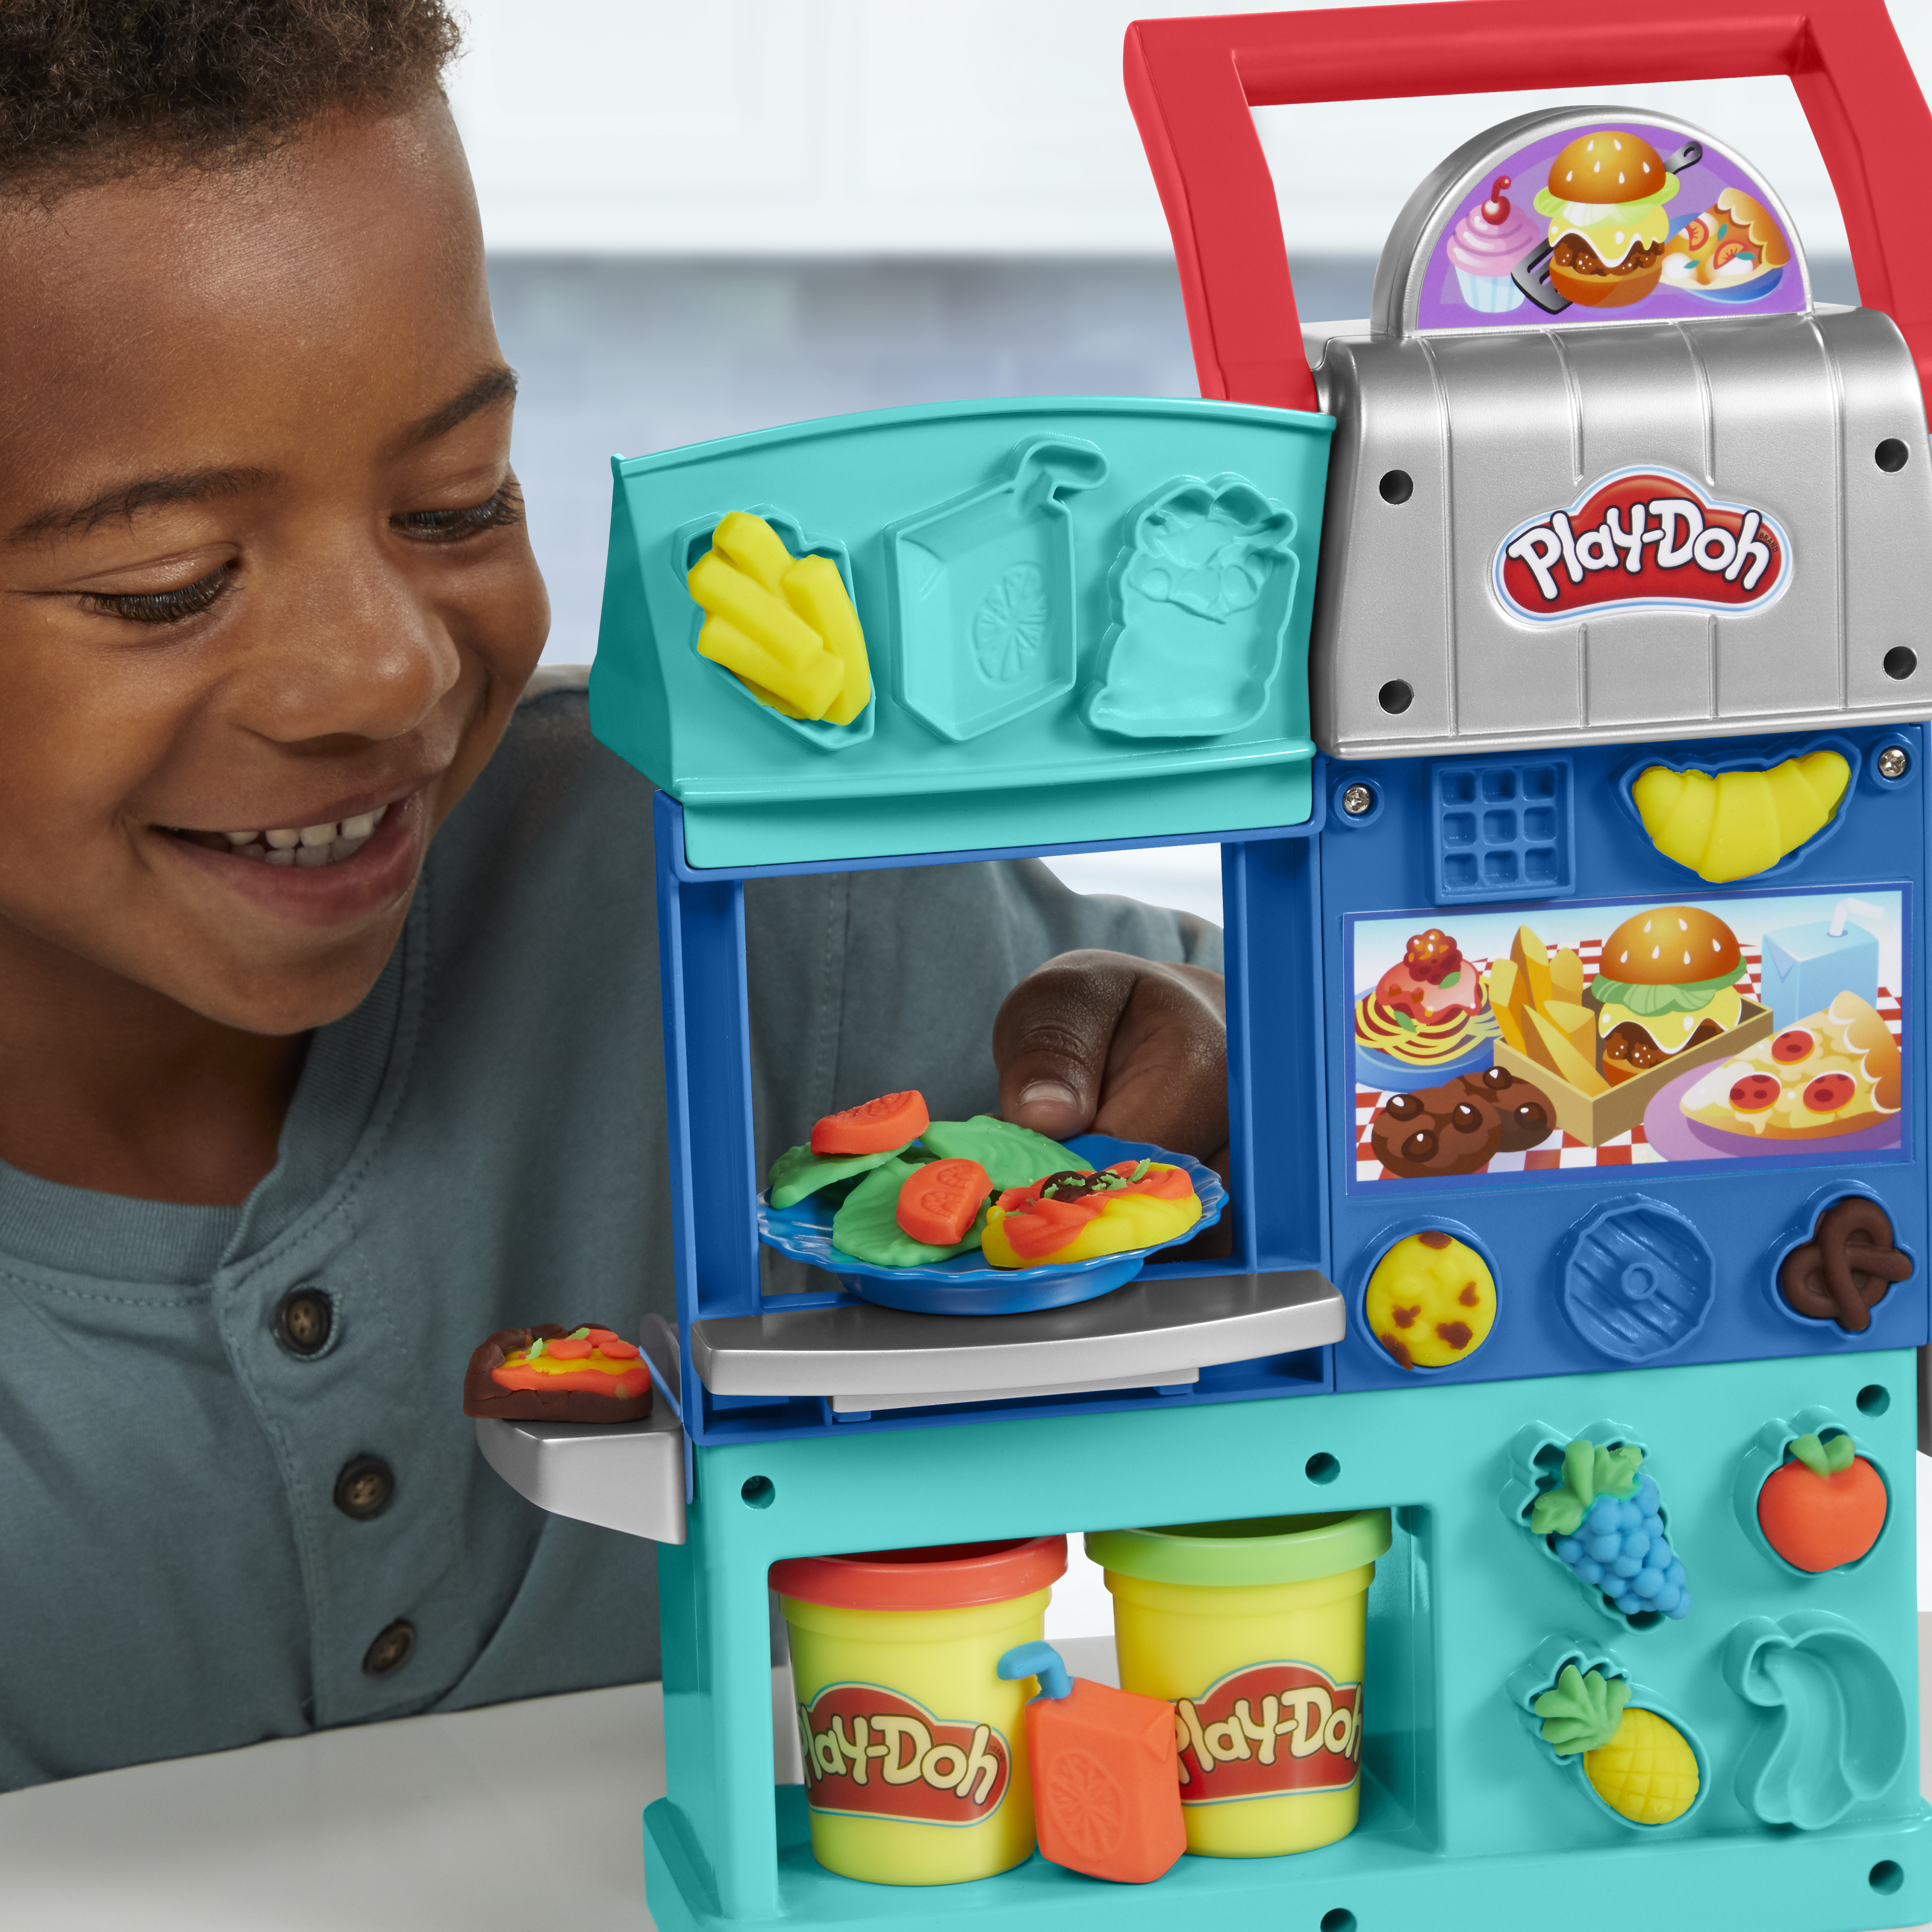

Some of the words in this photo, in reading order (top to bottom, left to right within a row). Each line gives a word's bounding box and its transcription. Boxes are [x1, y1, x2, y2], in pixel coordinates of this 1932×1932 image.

[1506, 498, 1771, 602] Play-Doh
[1760, 532, 1779, 552] BRAND
[988, 1744, 1005, 1763] BRAND
